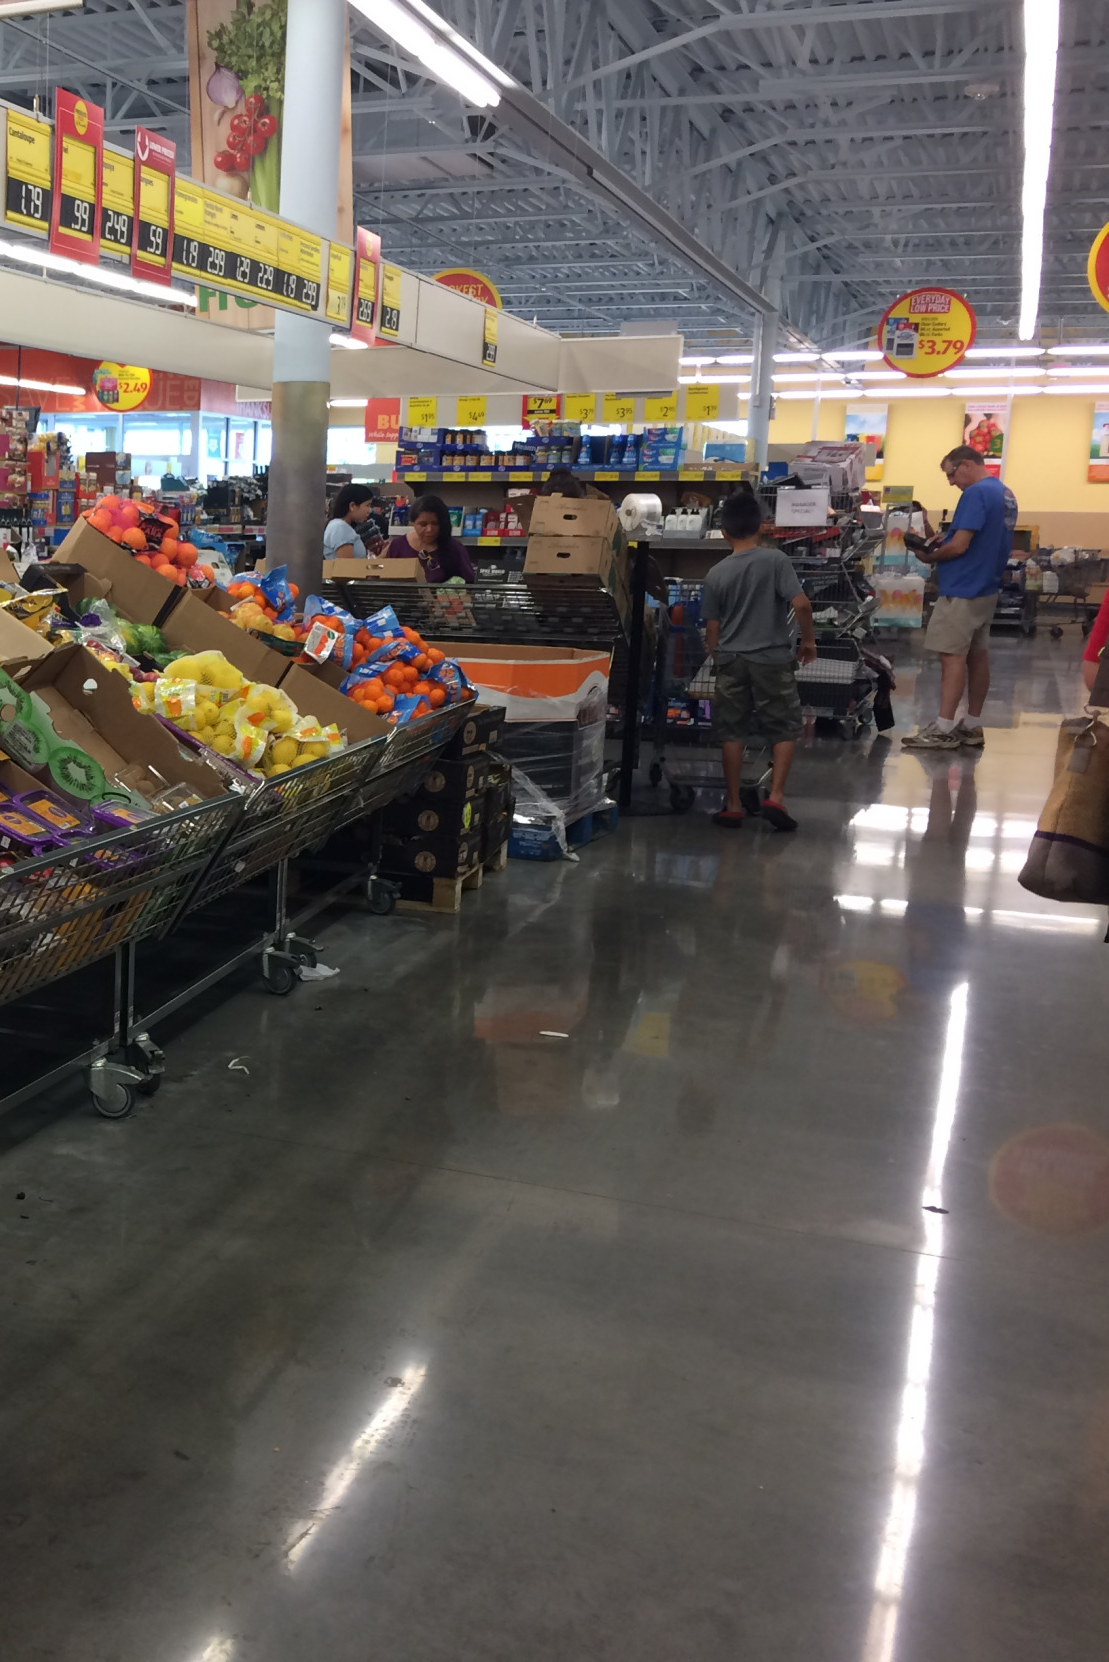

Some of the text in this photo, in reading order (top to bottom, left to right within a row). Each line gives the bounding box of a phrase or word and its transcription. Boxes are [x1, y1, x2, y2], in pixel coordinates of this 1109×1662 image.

[8, 126, 35, 145] Cantaloupe
[21, 184, 42, 218] 1.79
[71, 199, 90, 231] .99
[105, 210, 128, 243] 2.49
[146, 225, 163, 255] .59
[910, 303, 949, 313] LOW PRICE
[911, 294, 951, 305] EVERYDAY
[918, 339, 965, 355] $3.79
[118, 382, 148, 394] $2.49
